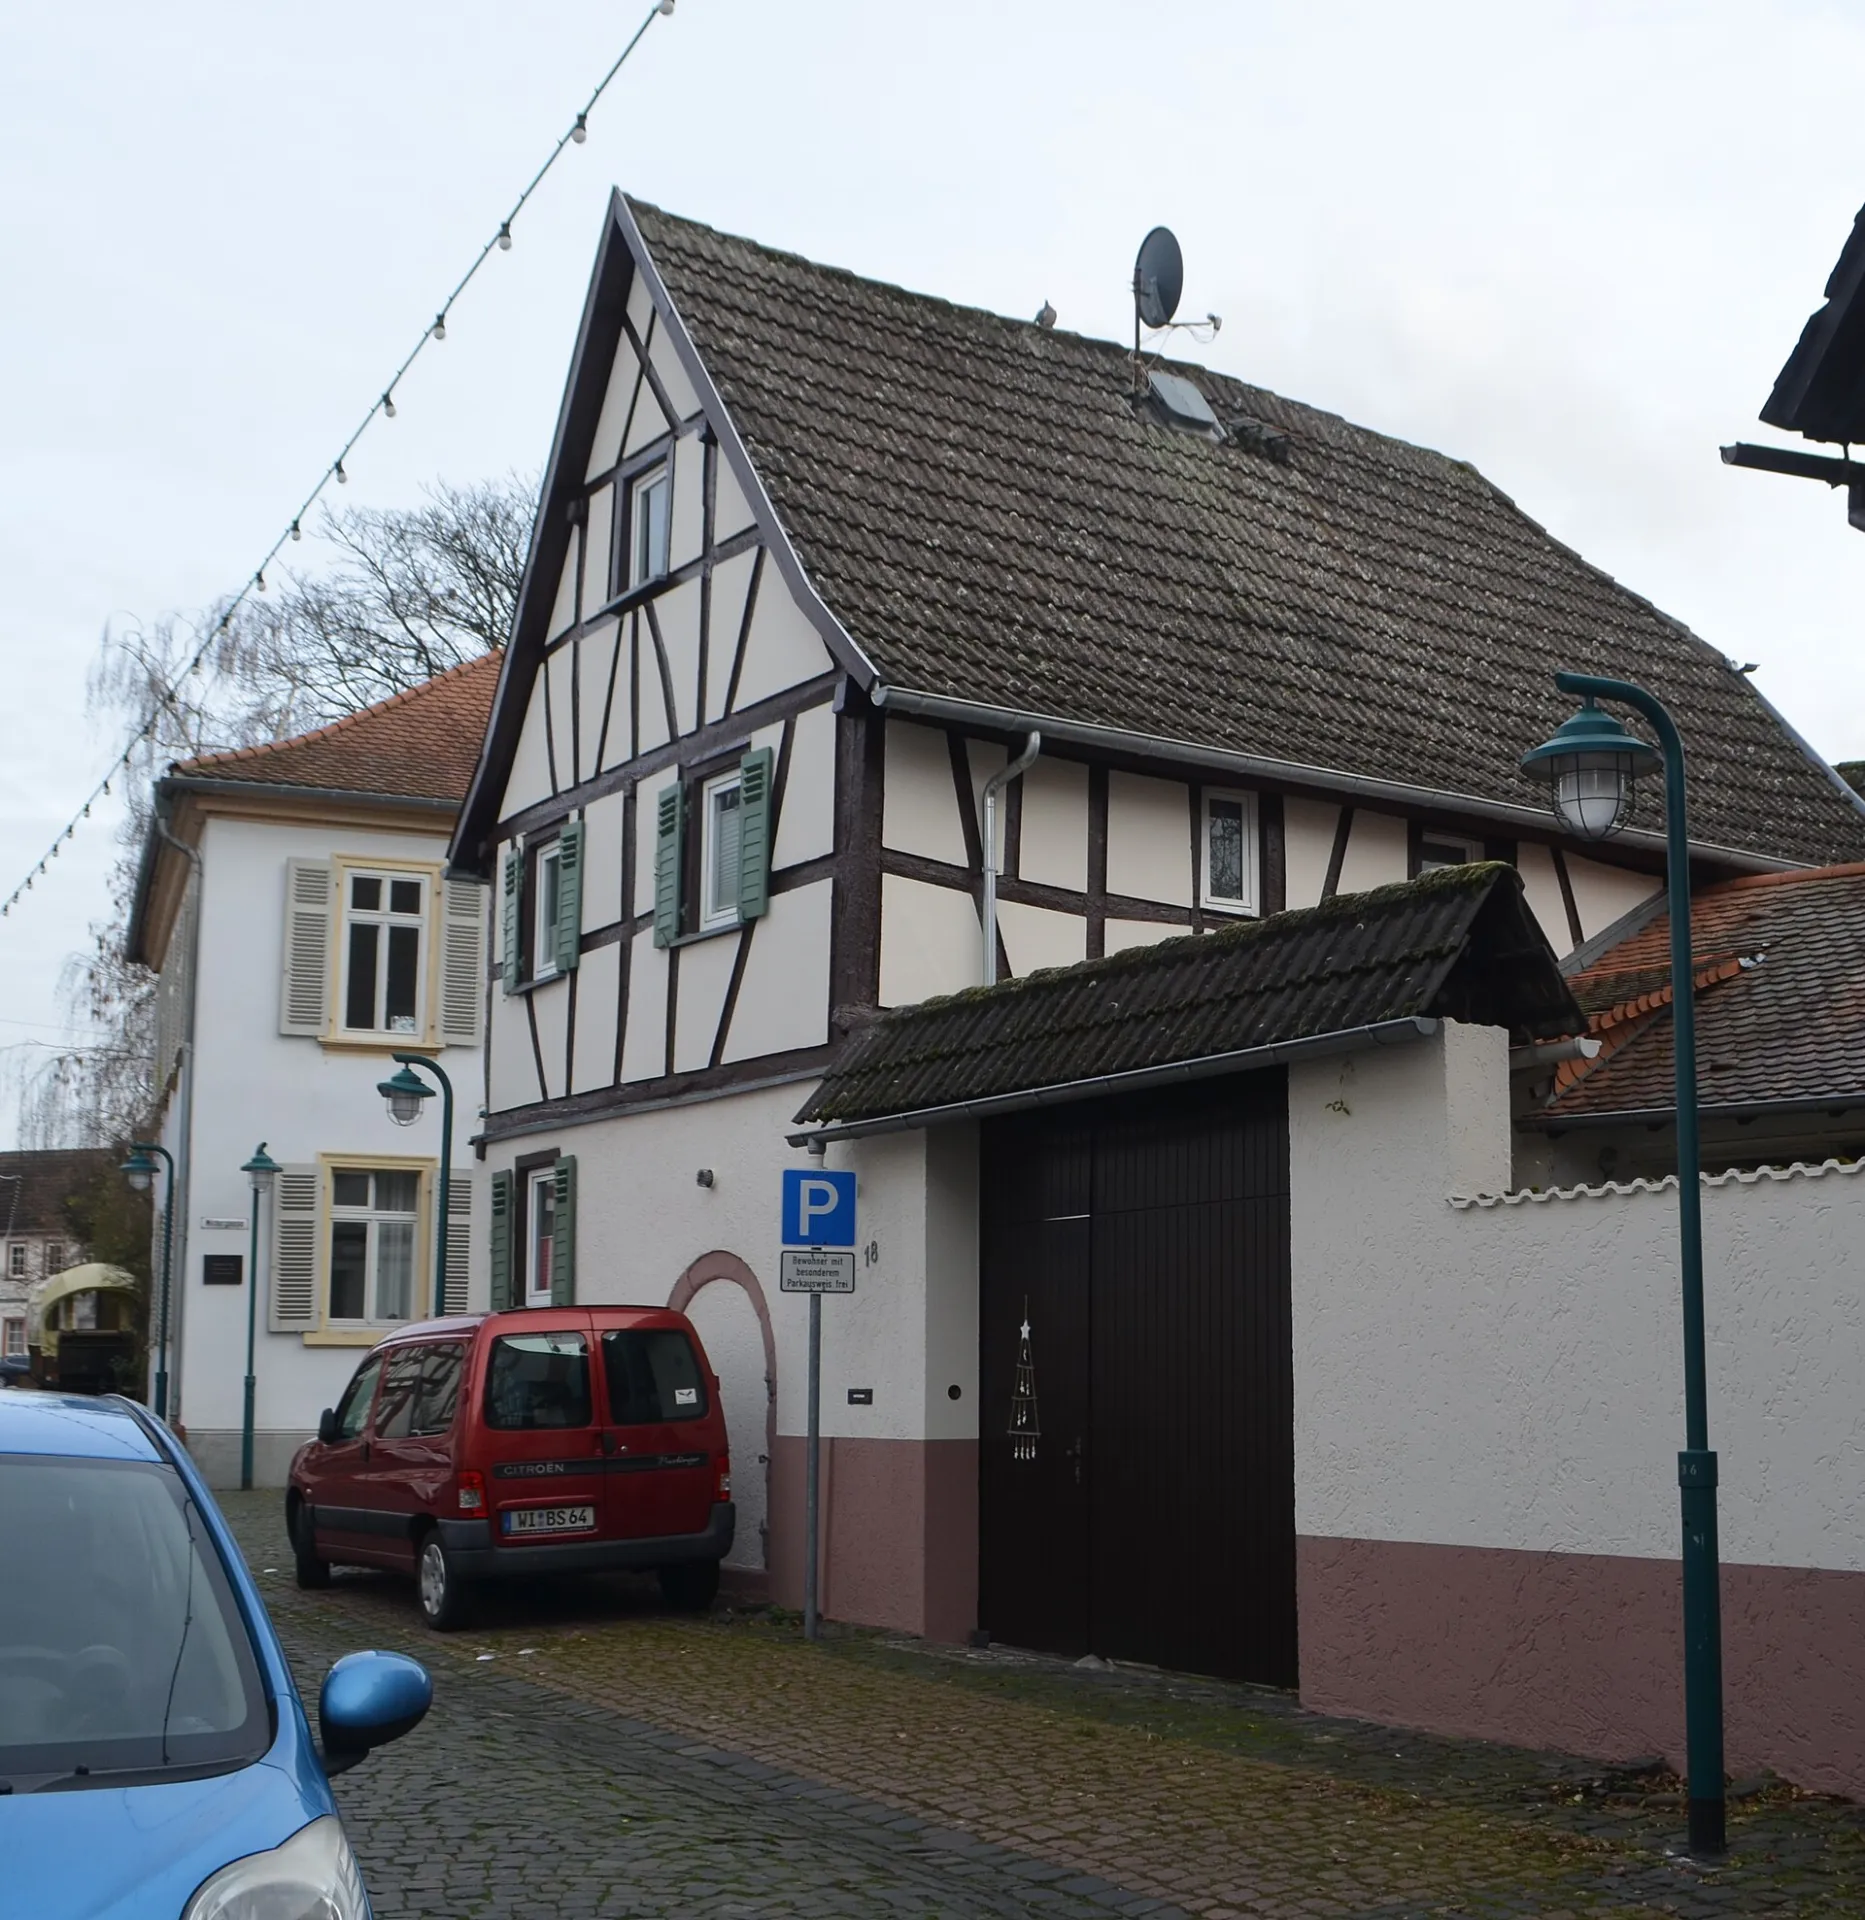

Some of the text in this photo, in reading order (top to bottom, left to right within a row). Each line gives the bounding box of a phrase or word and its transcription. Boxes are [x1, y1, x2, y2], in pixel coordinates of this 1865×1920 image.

[799, 1179, 839, 1236] P
[864, 1240, 878, 1268] 18
[792, 1255, 843, 1266] Bewohner mit
[796, 1267, 840, 1277] besonderem
[787, 1278, 849, 1289] Parkausweis frei
